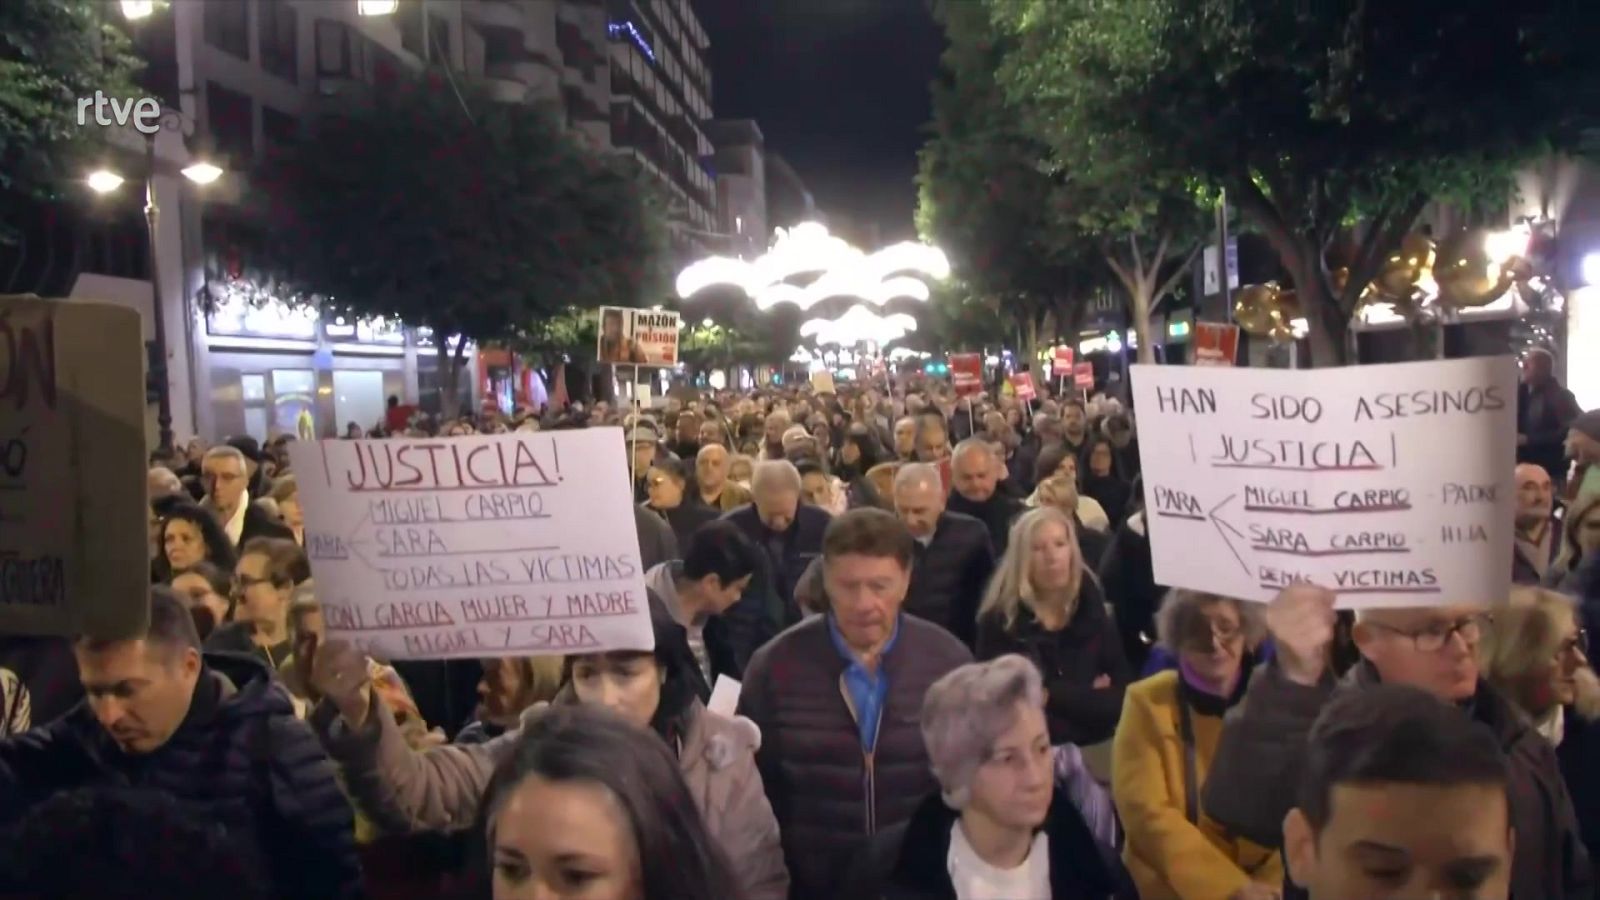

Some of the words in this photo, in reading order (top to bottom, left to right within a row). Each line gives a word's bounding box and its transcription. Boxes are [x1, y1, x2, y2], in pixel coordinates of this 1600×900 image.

[638, 313, 677, 327] MAZÓN
[1157, 386, 1217, 414] HAN
[1251, 393, 1322, 423] SIDO
[1354, 386, 1505, 422] ASESINOS
[371, 496, 449, 523] MIGUEL
[465, 491, 543, 520] CARPIO
[1154, 485, 1203, 514] PARA
[1245, 485, 1317, 510] MIGUEL
[1334, 487, 1410, 510] CARPIO
[376, 528, 446, 554] SARA
[1249, 524, 1310, 551] SARA
[1330, 532, 1406, 549] CARPIO
[384, 565, 454, 590] TODAS
[463, 561, 510, 587] LAS
[520, 554, 636, 583] VICTIMAS
[1334, 568, 1437, 587] VICTIMAS
[375, 600, 453, 628] GARCIA
[461, 594, 528, 621] MUJER
[543, 595, 553, 618] Y
[566, 590, 635, 616] MADRE
[500, 626, 511, 647] Y
[531, 624, 600, 648] SARA
